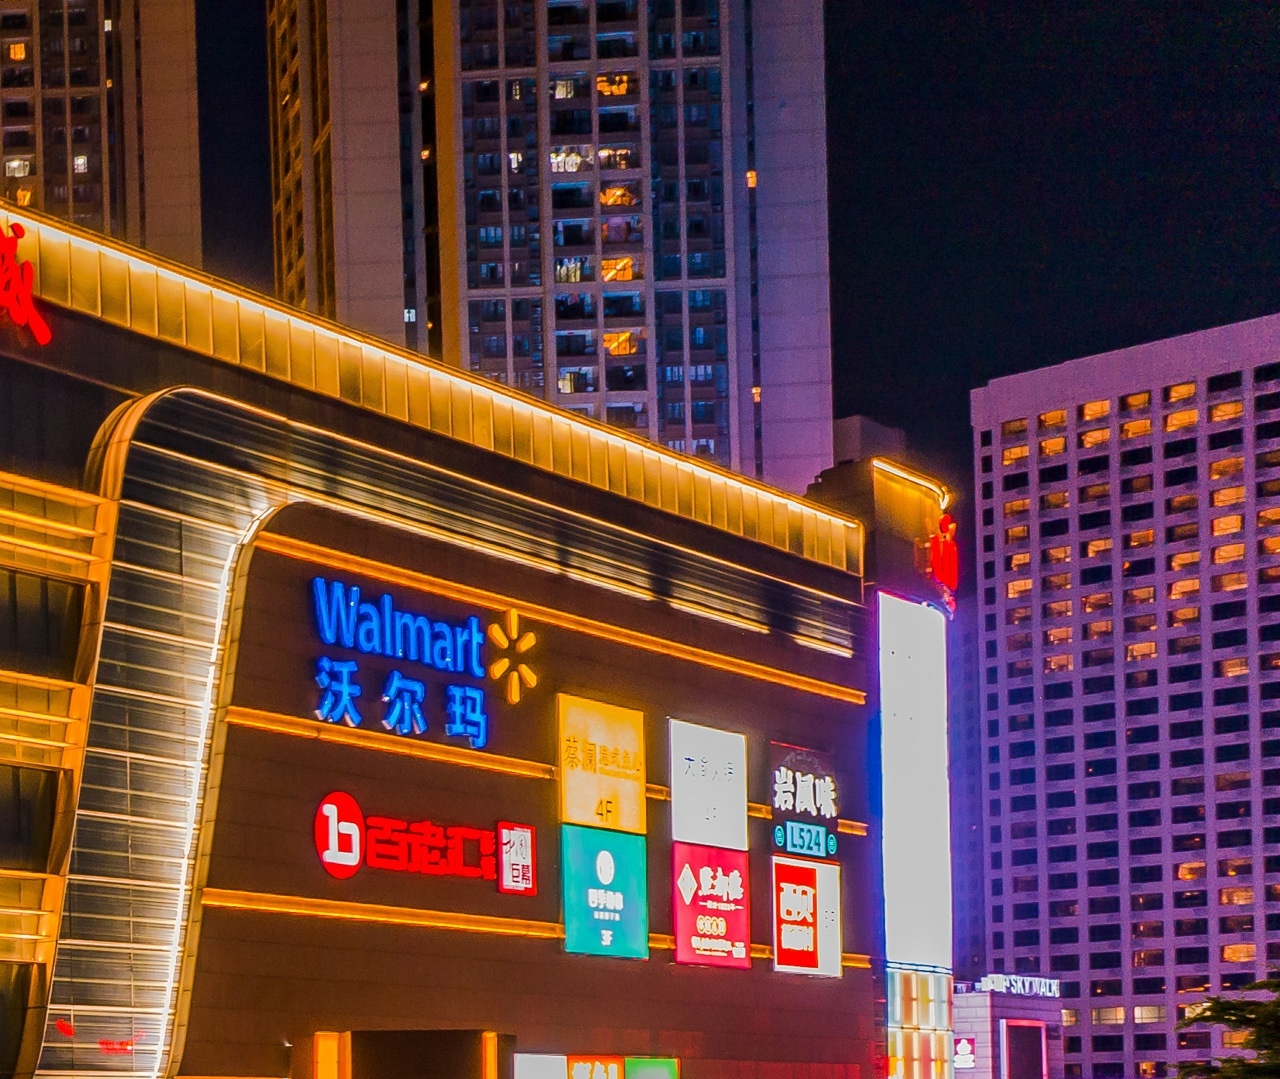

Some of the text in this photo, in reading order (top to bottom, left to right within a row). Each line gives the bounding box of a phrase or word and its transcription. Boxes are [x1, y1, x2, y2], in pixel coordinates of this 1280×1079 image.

[312, 577, 486, 678] Walmart
[315, 656, 488, 748] 沃尔玛
[595, 800, 613, 822] 4F
[791, 825, 821, 853] L524
